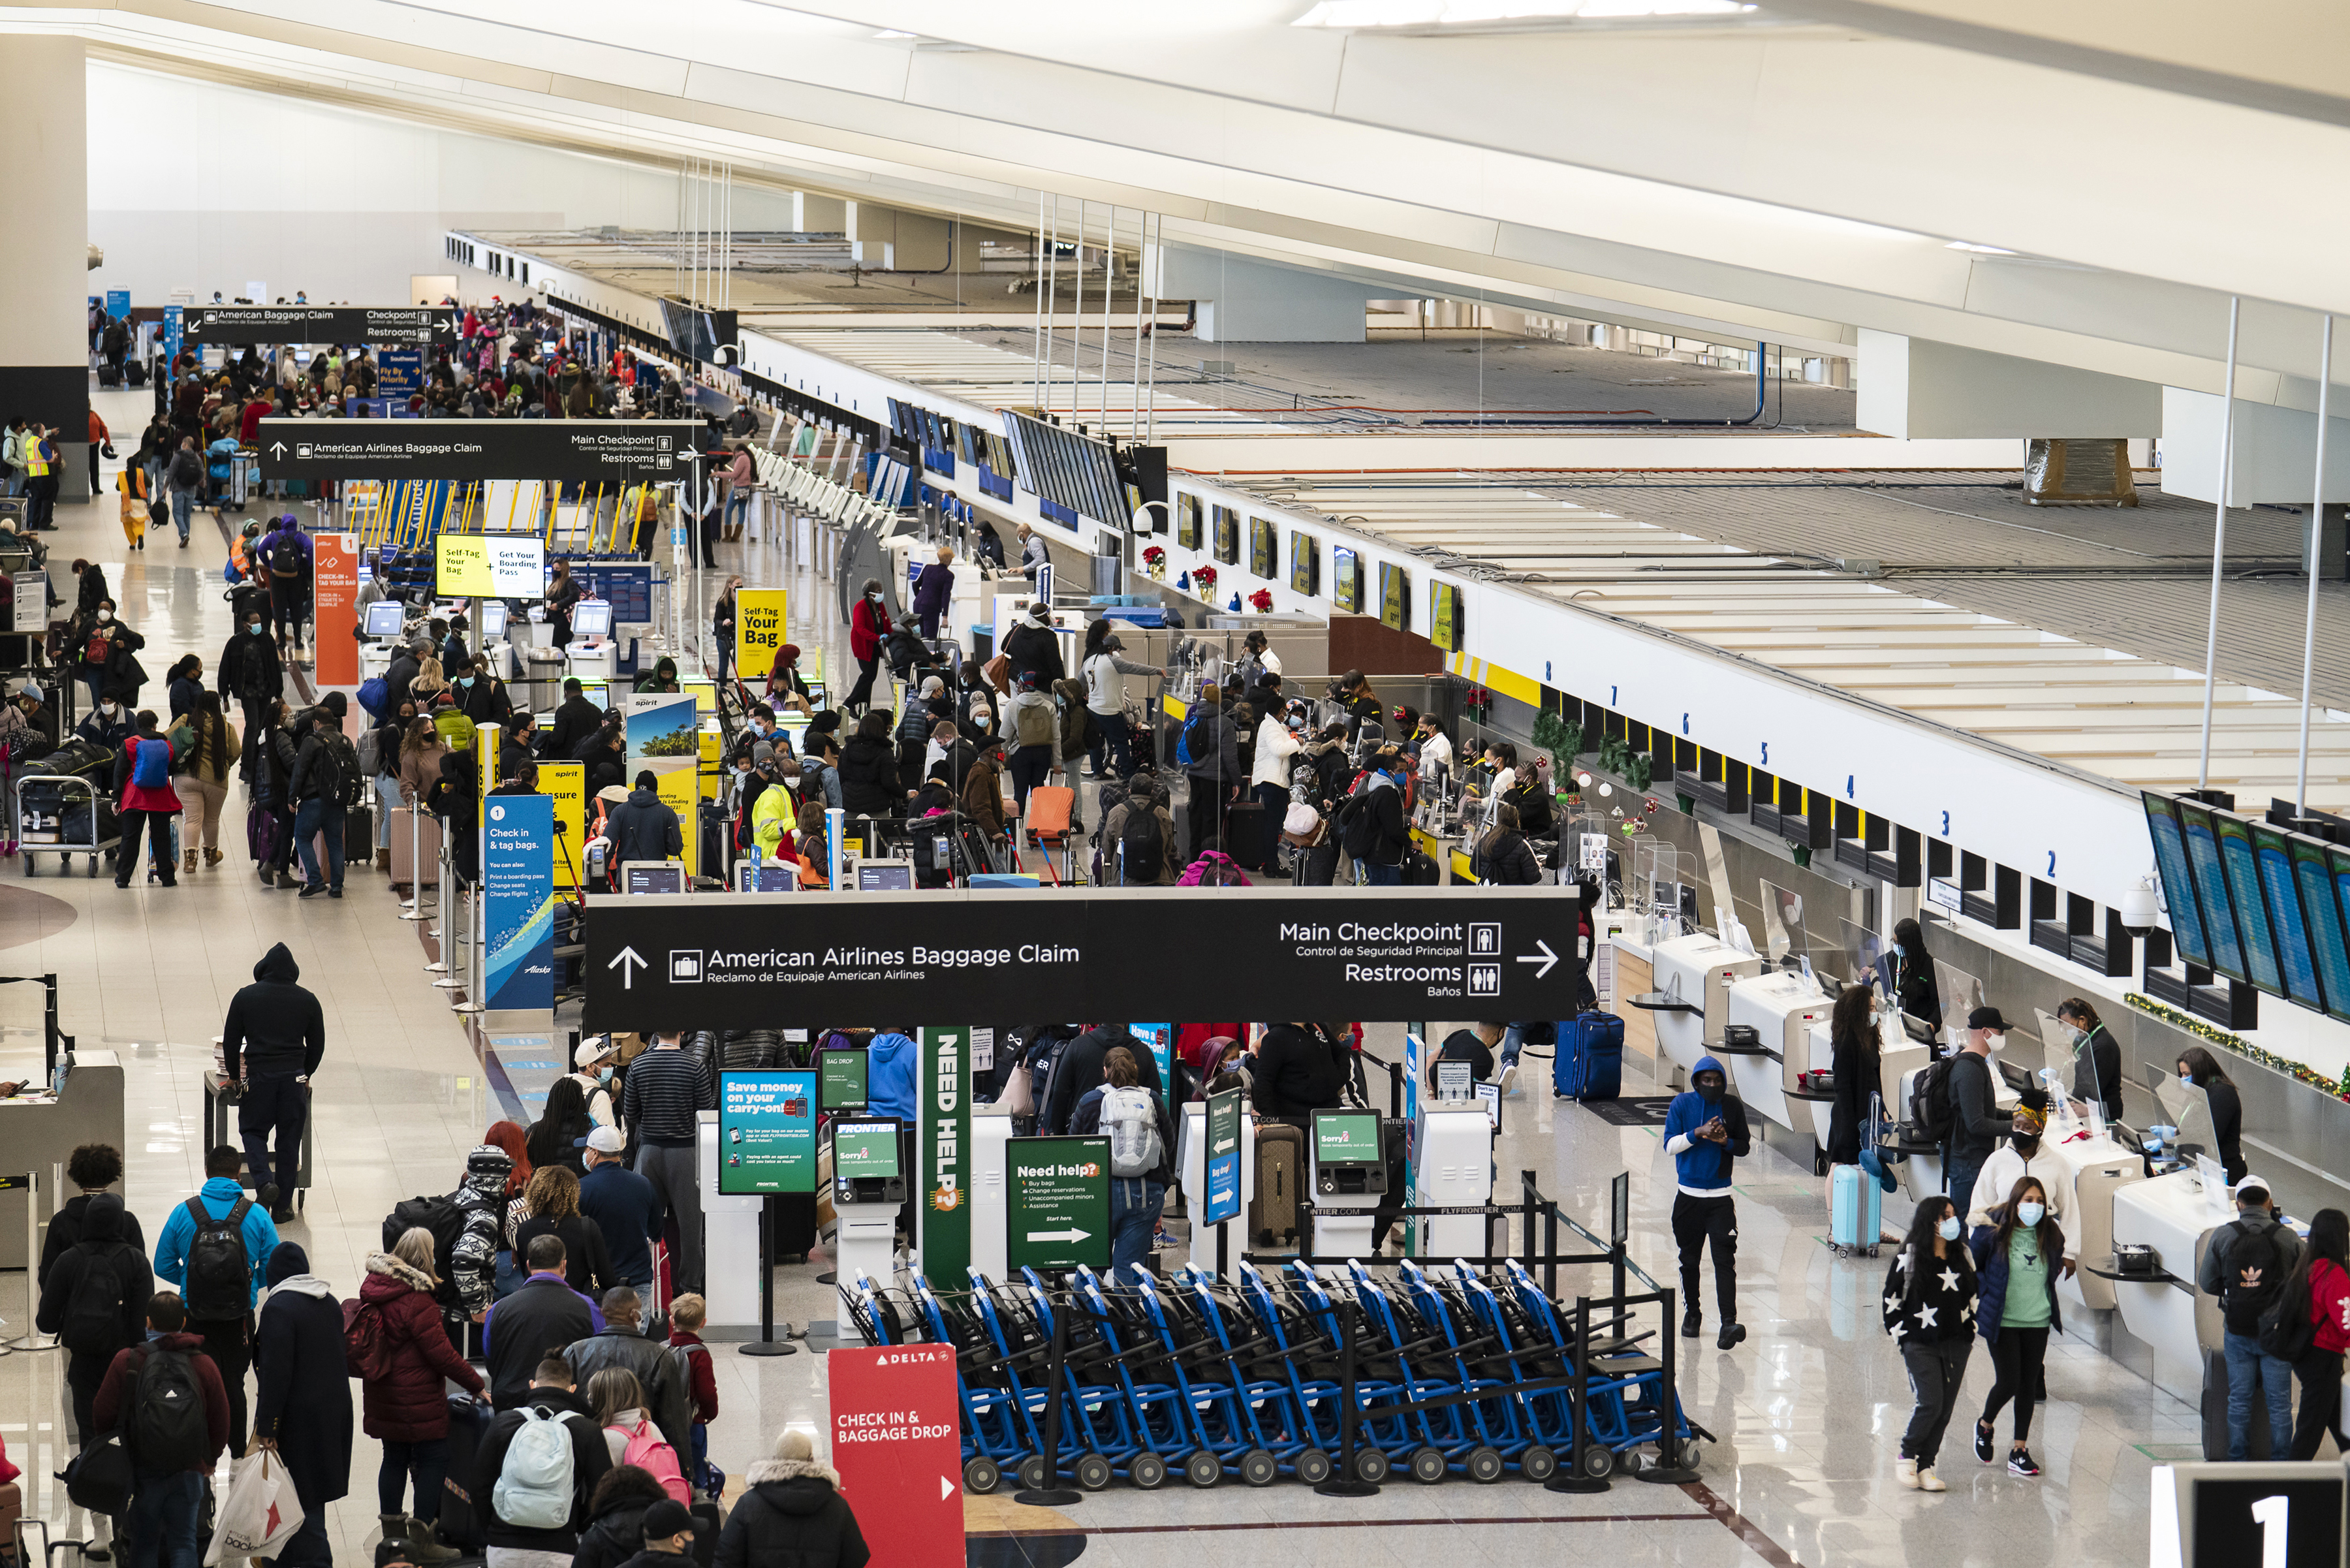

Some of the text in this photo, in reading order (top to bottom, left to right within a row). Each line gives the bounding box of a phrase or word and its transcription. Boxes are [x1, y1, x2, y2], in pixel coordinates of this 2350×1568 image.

[218, 311, 334, 321] American Baggage Claim
[366, 311, 416, 321] Checkpoint
[368, 328, 416, 336] Restrooms
[381, 368, 403, 377] Fly By
[381, 376, 409, 384] Priority
[572, 435, 655, 445] Main Checkpoint
[315, 443, 482, 454] American Airlines Baggage Claim
[601, 454, 655, 463] Restrooms
[347, 539, 352, 549] 1
[446, 550, 480, 558] Self-Tag
[499, 560, 537, 569] Boarding
[446, 567, 462, 575] Bag
[744, 608, 778, 617] Self-Tag
[1390, 612, 1400, 624] spirit
[744, 616, 779, 629] Your
[745, 630, 778, 648] Bag
[1441, 632, 1451, 645] spirit
[1546, 661, 1552, 682] 8
[1611, 685, 1618, 706] 7
[1683, 712, 1689, 735] 6
[1761, 742, 1768, 765] 5
[1847, 775, 1854, 799] 4
[1942, 810, 1950, 836] 3
[521, 828, 529, 837] in
[499, 841, 513, 851] tag
[516, 841, 539, 851] bags.
[2048, 850, 2056, 877] 2
[1280, 922, 1462, 944] Main Checkpoint
[708, 945, 1079, 967] American Airlines Baggage Claim
[1296, 946, 1462, 957] Control de Seguridad Principal
[525, 965, 551, 974] Alaska
[1346, 964, 1462, 981] Restrooms
[708, 970, 925, 983] Reclamo de Equipaje American Airlines
[1428, 987, 1461, 996] Baños
[1131, 1025, 1155, 1041] Have a
[727, 1082, 803, 1093] Save money
[727, 1094, 776, 1104] on your
[727, 1103, 785, 1114] carry-on!
[937, 1034, 958, 1207] NEED HELP?
[838, 1123, 896, 1133] FRONTIER
[1018, 1164, 1097, 1178] Need help?
[1441, 1206, 1521, 1215] FLYFRONTIER.COM
[891, 1353, 935, 1364] DELTA
[838, 1411, 919, 1427] CHECK IN &
[839, 1425, 951, 1443] BAGGAGE DROP
[2251, 1496, 2289, 1568] 1
